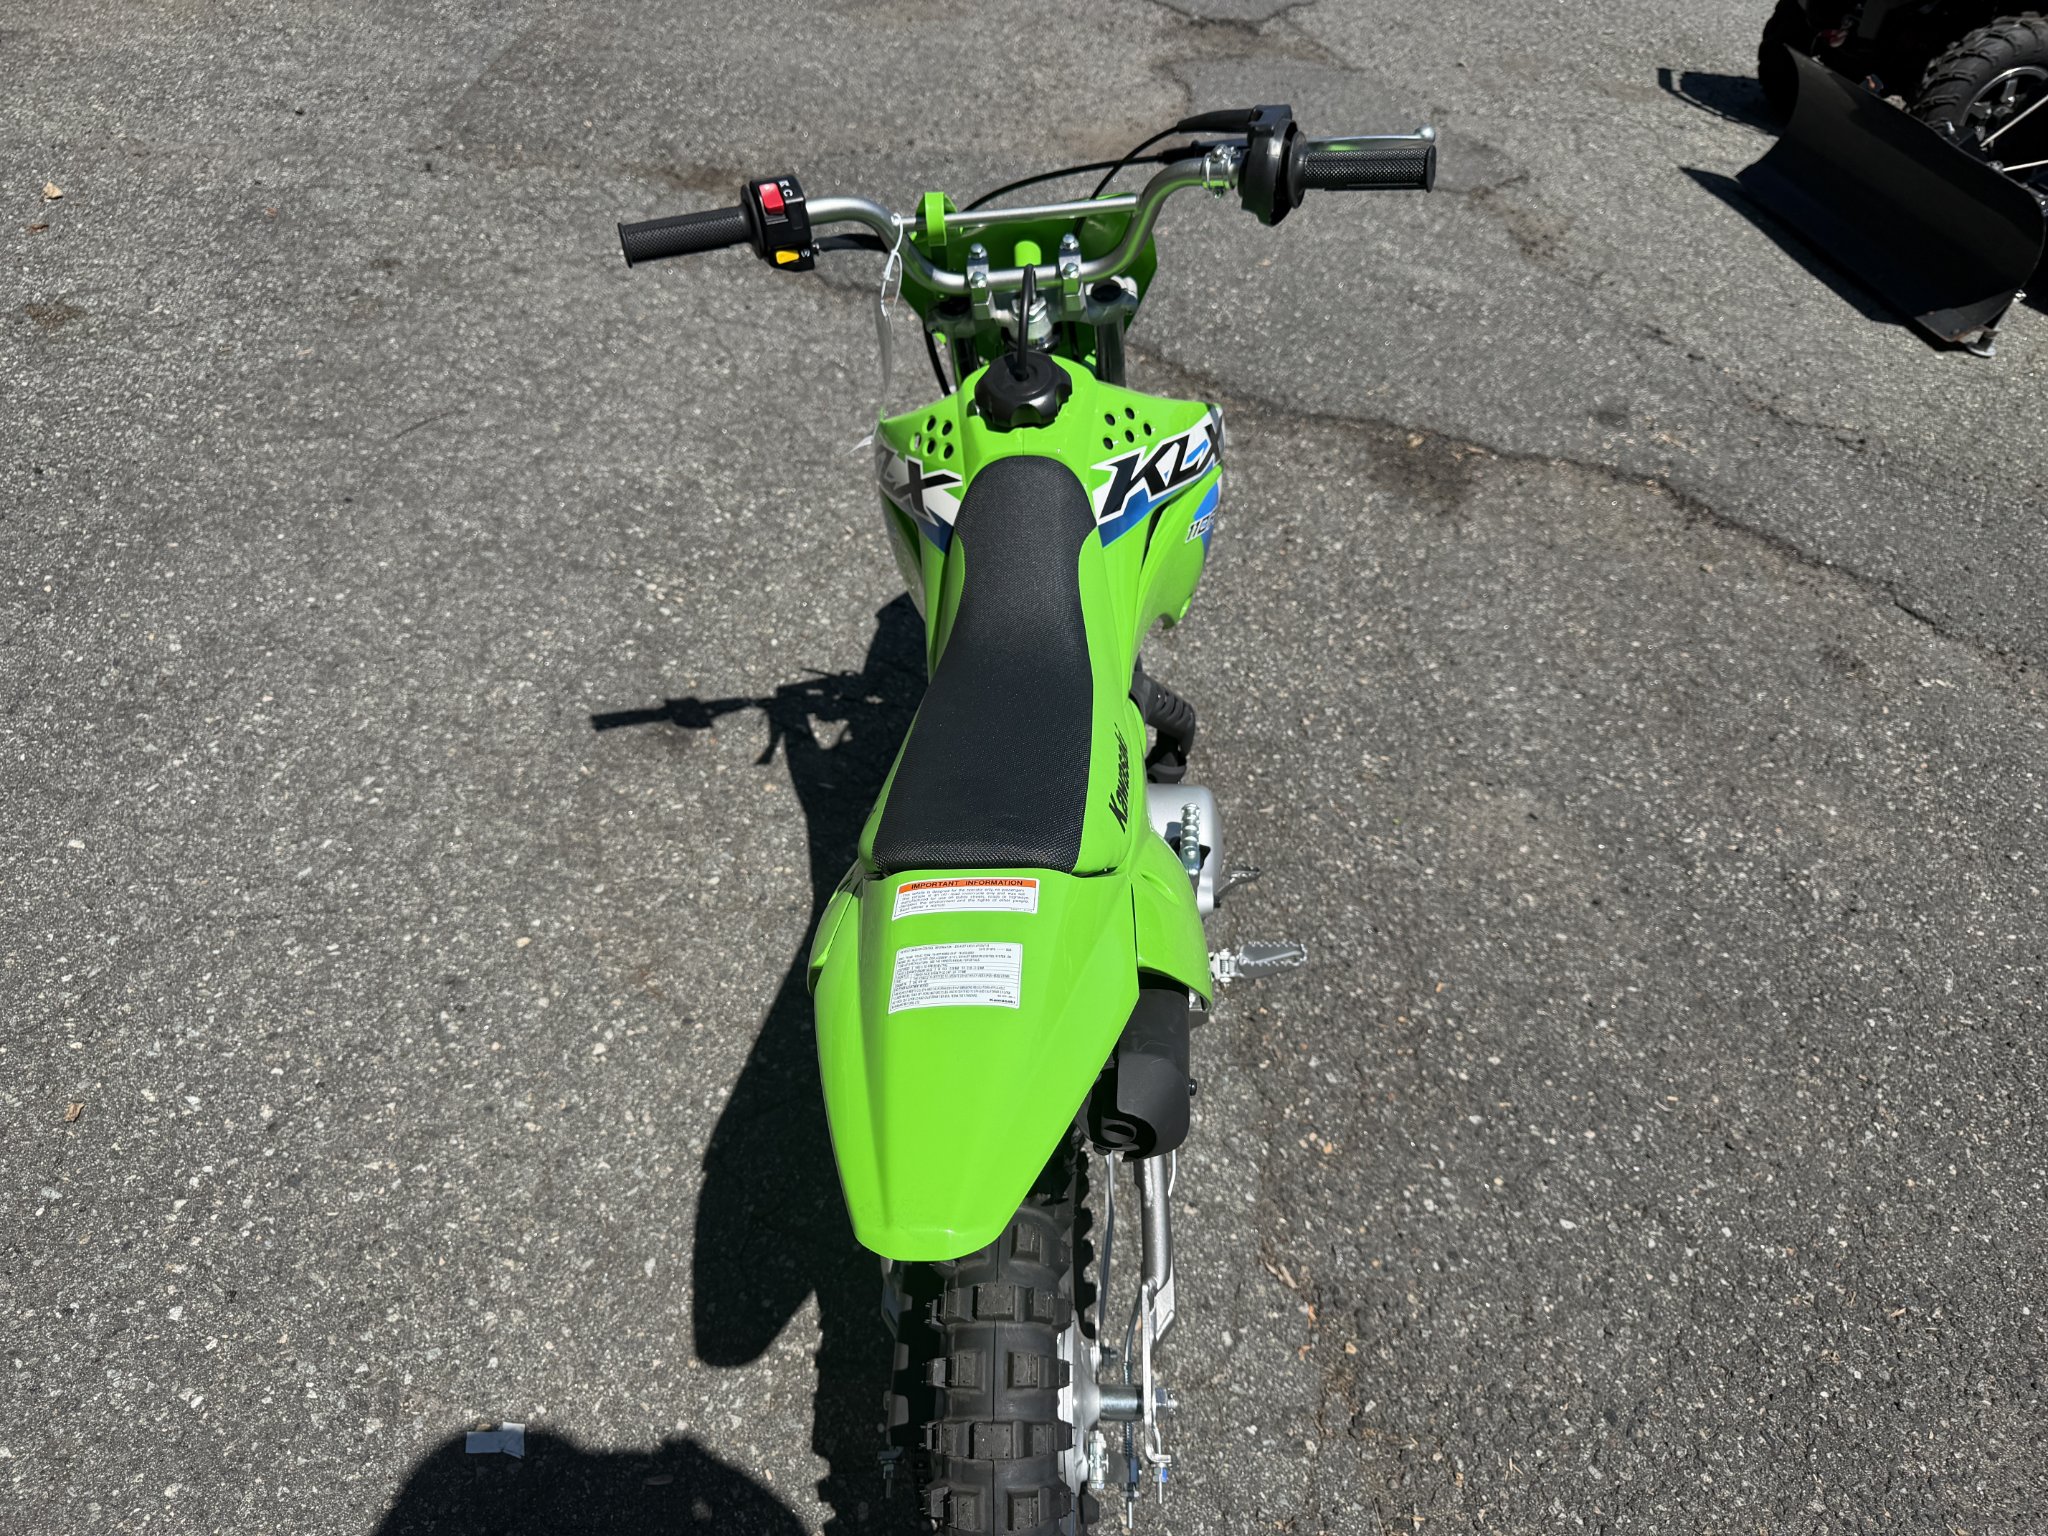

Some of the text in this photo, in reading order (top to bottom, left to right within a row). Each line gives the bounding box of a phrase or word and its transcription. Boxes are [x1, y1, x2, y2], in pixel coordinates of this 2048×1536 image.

[1098, 423, 1222, 520] KLX
[1108, 722, 1130, 834] Kawasaki
[911, 881, 960, 890] IMPORTANT
